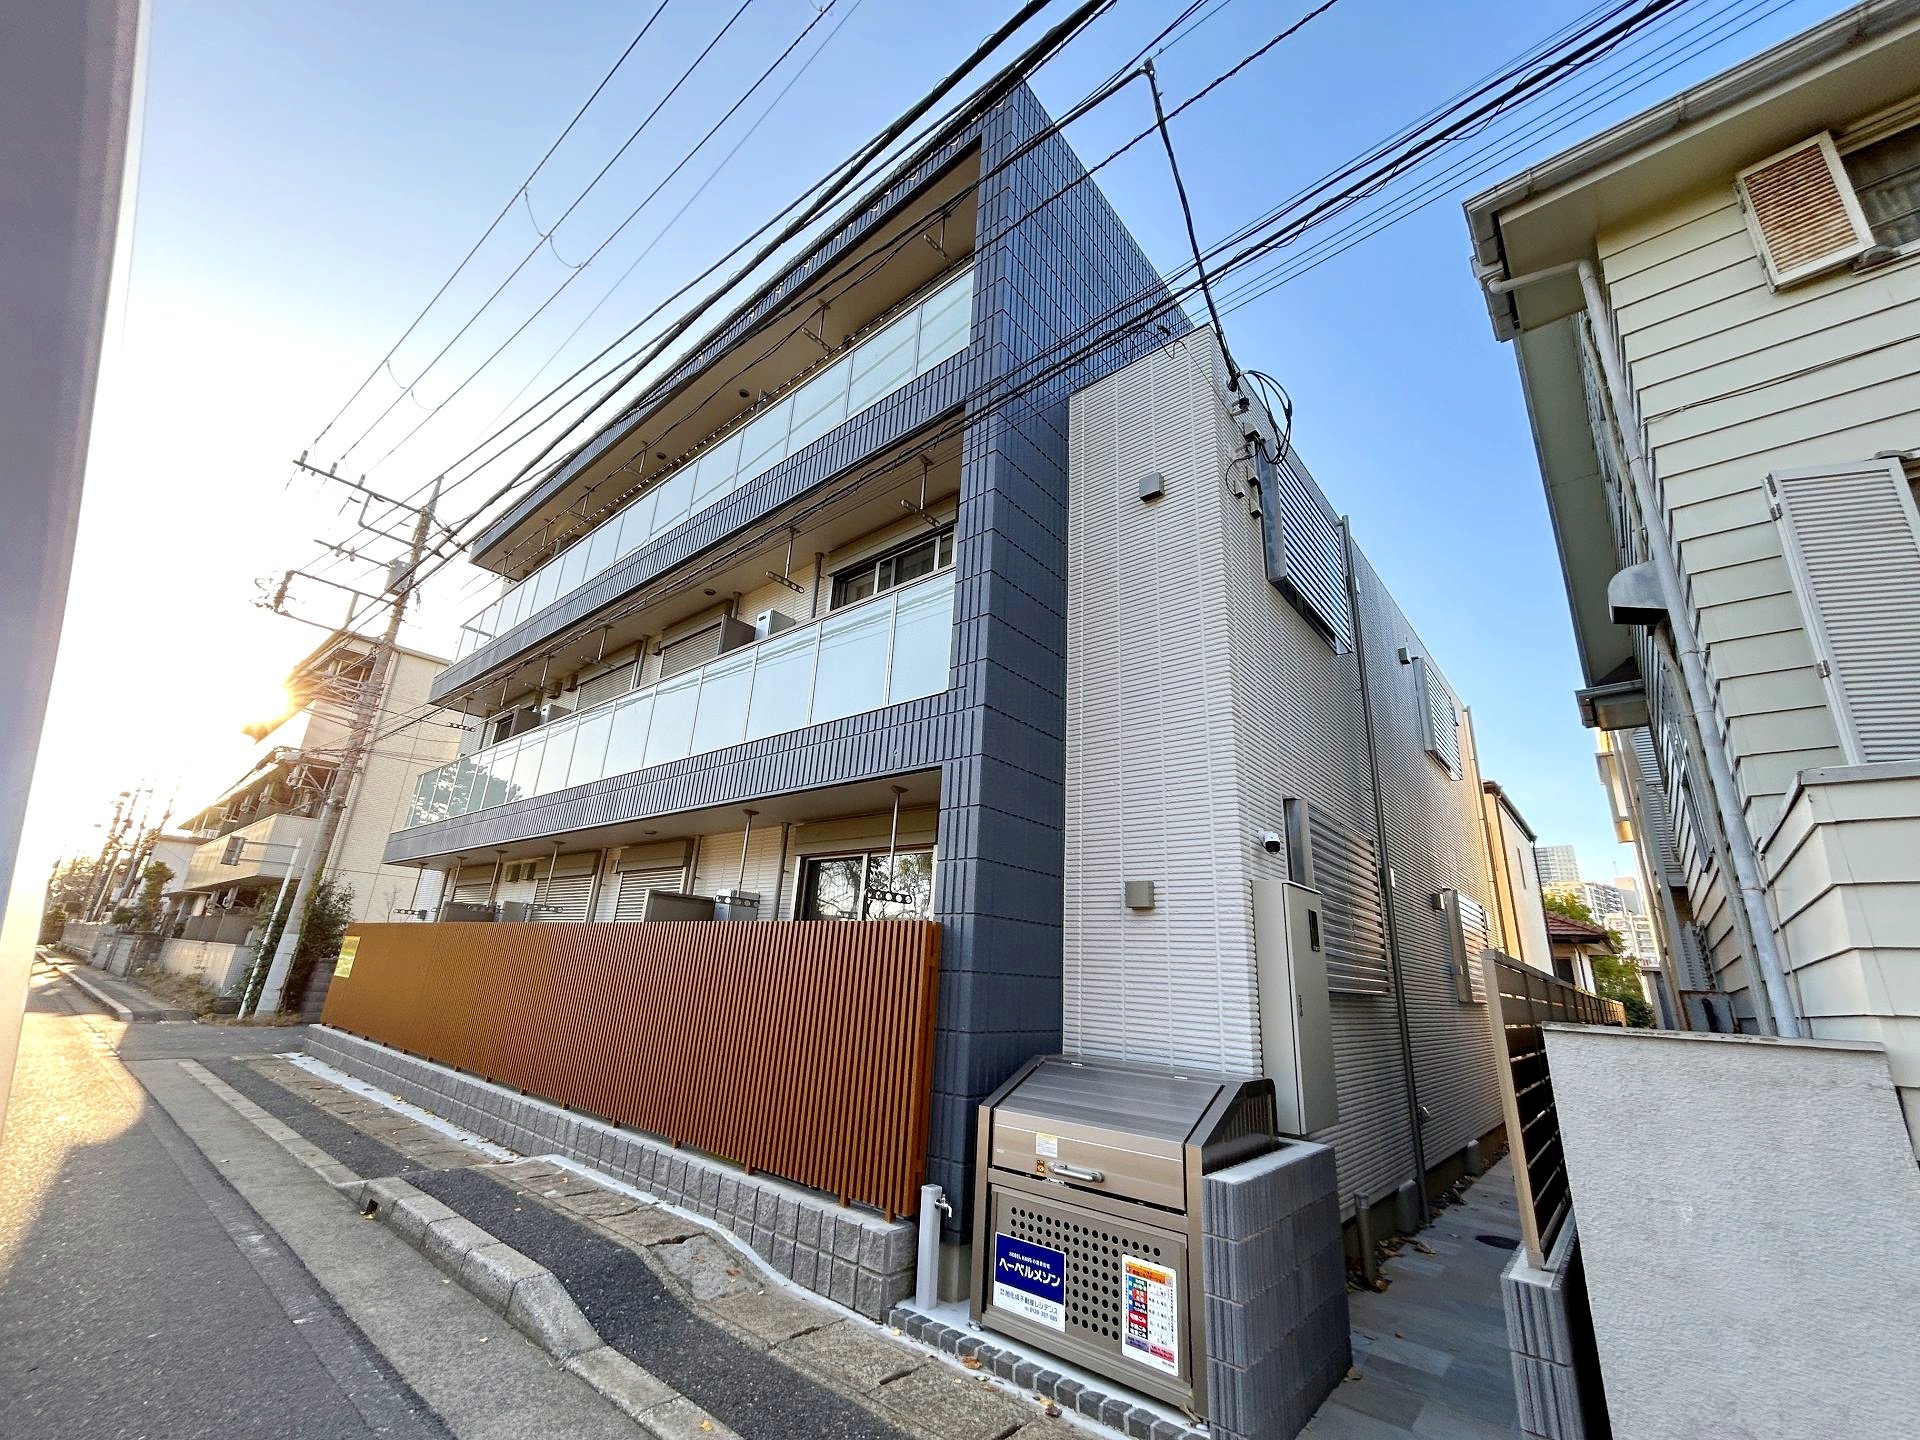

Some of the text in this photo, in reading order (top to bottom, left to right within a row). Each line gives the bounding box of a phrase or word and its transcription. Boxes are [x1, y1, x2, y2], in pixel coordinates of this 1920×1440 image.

[999, 1257, 1061, 1287] ヘーベルメゾン
